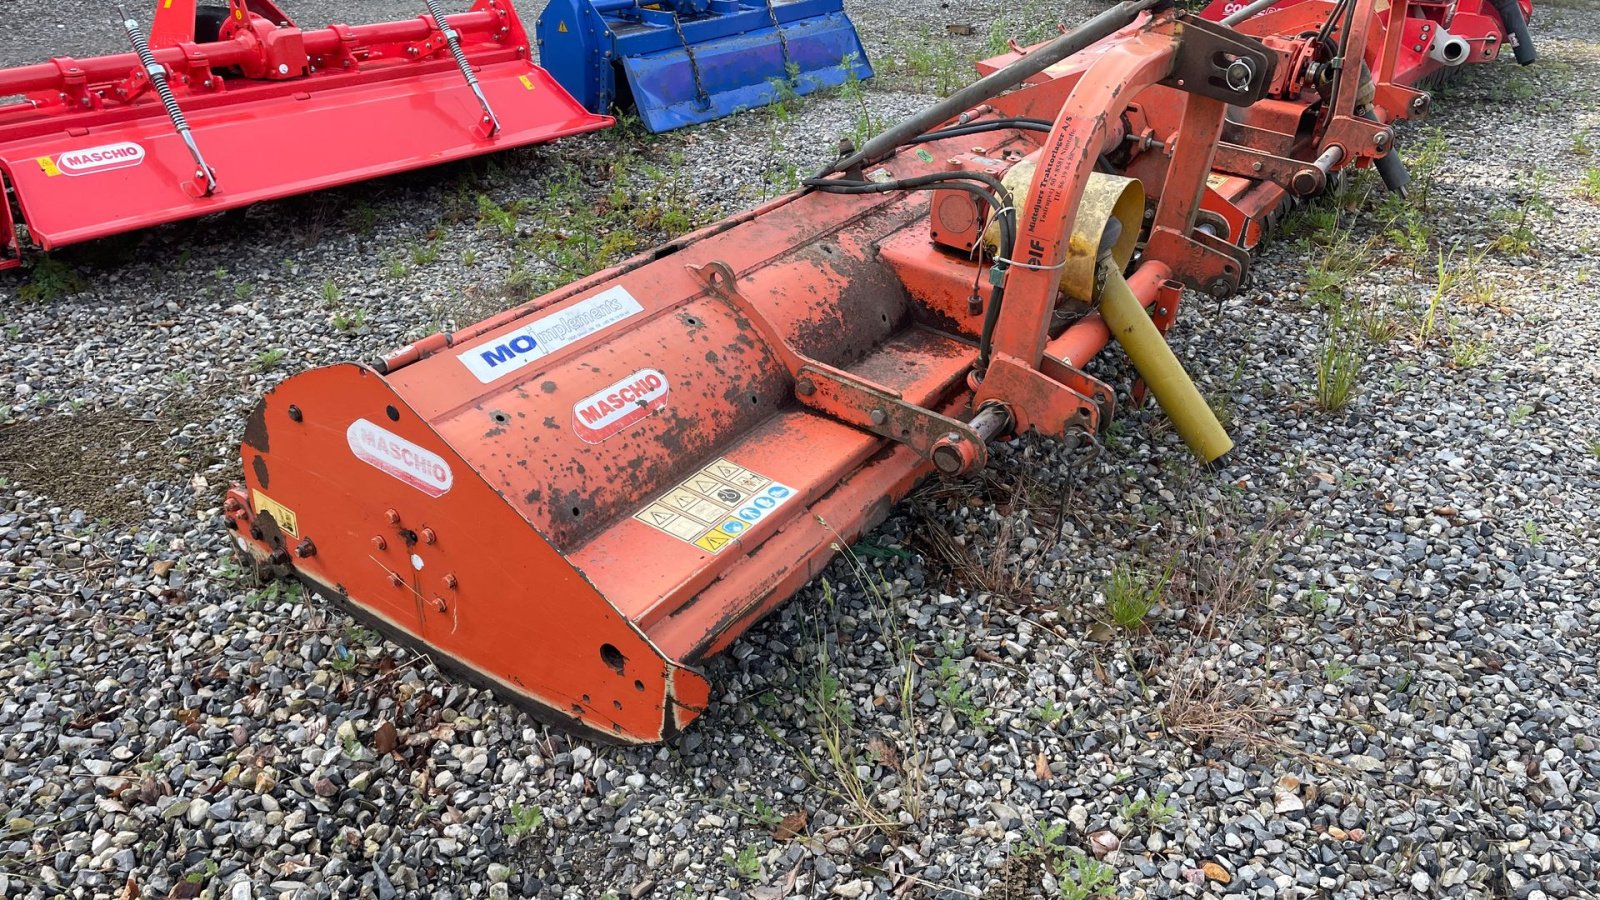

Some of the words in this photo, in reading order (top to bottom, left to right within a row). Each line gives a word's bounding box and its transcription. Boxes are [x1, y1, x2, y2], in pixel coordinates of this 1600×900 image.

[67, 146, 138, 166] MASCHIO
[1039, 132, 1065, 187] Traktorlager
[1062, 116, 1072, 132] A/S
[480, 335, 537, 368] MO
[580, 374, 661, 424] MASCHIO
[361, 427, 446, 483] MASCHIO
